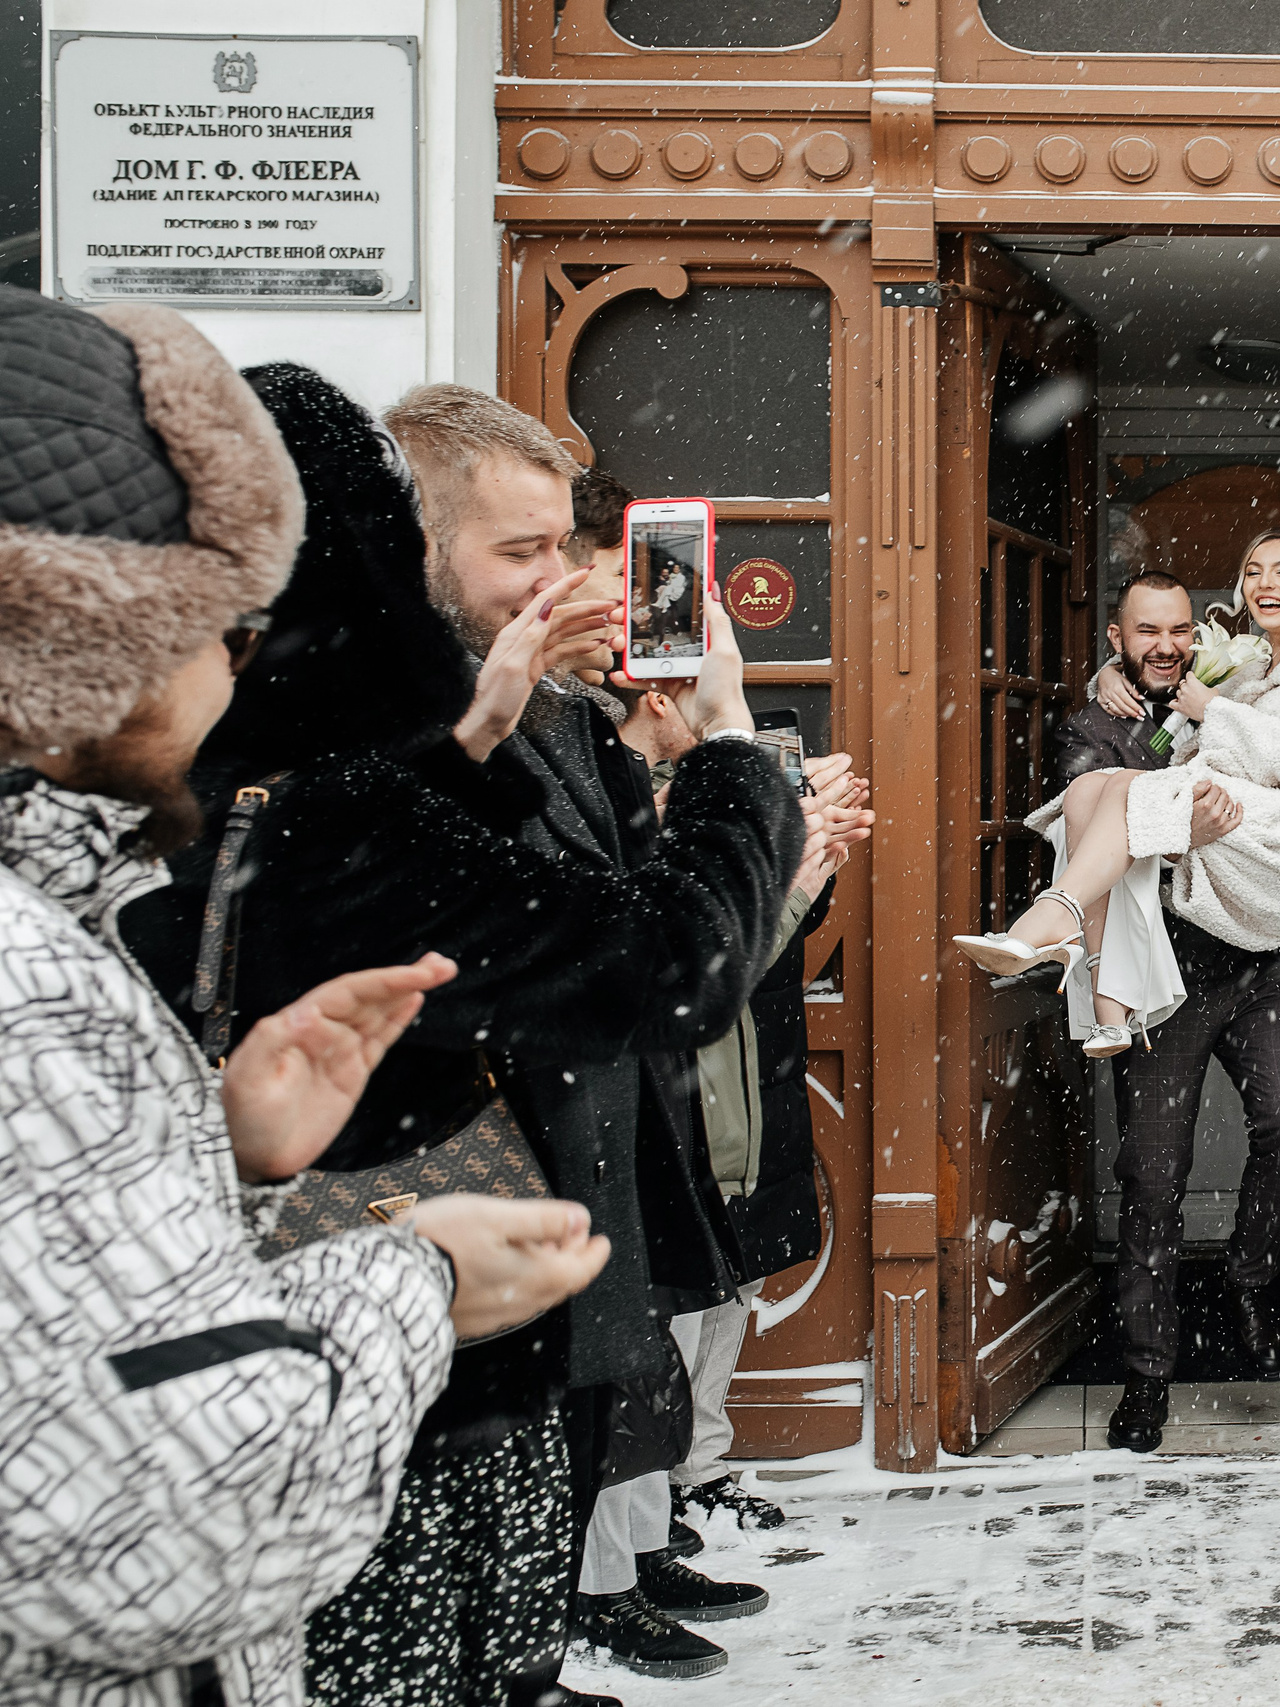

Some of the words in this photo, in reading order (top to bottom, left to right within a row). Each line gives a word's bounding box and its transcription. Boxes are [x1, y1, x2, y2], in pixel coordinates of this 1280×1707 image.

[94, 103, 160, 117] ОБЪЕКТ
[164, 104, 283, 119] КУЛЬТРНОГО
[286, 106, 375, 121] НАСЛЕДИЯ
[129, 122, 263, 138] ФЕДЕРАЛЬНОГО
[266, 125, 353, 139] ЗНАЧЕНИЯ
[112, 159, 180, 184] ДОМ
[186, 159, 206, 180] Г.
[214, 159, 244, 180] Ф.
[252, 160, 361, 181] ФЛЕЕРА
[92, 189, 158, 202] (ЗДАНИЕ
[291, 190, 380, 204] МАГАЗИНА)
[164, 219, 240, 229] ПОСТРОЕНО
[285, 219, 318, 231] ГОДУ
[87, 244, 173, 258] ПОДЛЕЖИТ
[176, 244, 326, 260] ГОСУДАРСТВЕННОЙ
